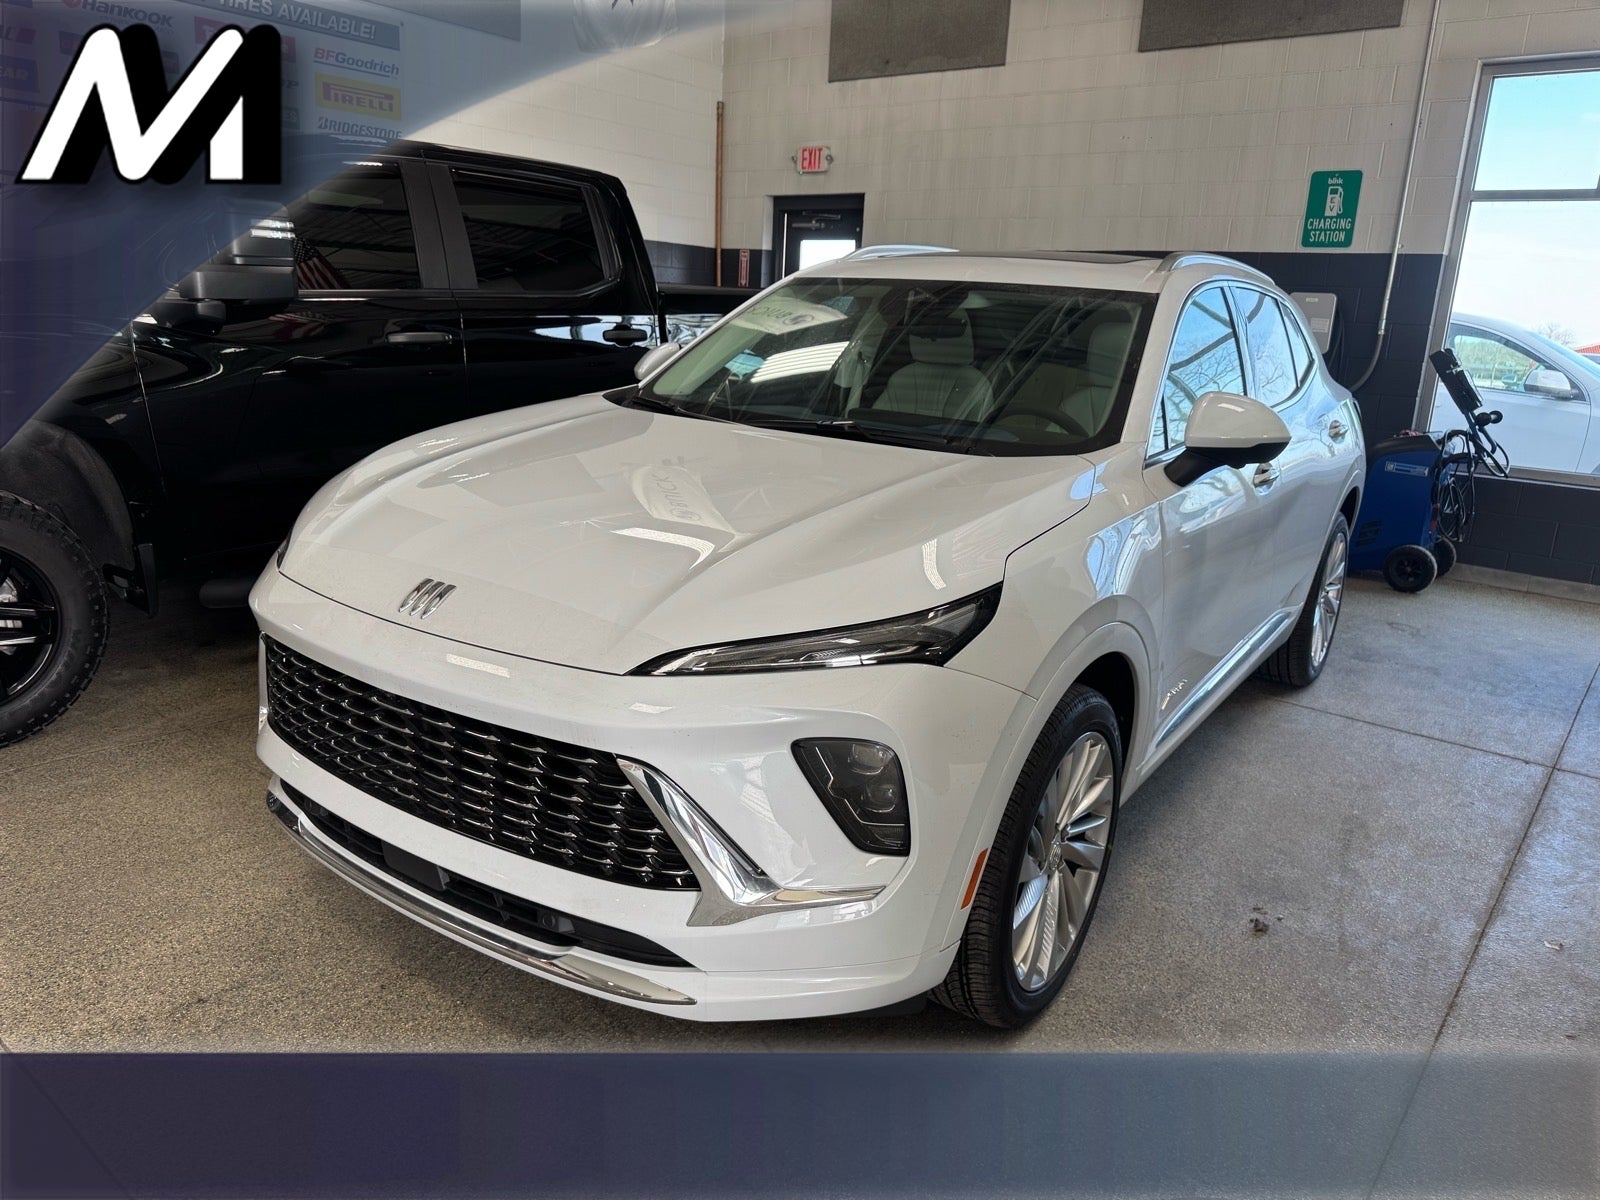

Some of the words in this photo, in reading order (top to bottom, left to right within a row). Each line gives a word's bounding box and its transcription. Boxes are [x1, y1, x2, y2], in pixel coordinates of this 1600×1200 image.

[277, 3, 377, 39] AVAILABLE!
[314, 47, 400, 76] BFGoodrich
[322, 81, 394, 113] PIRELLI
[801, 147, 823, 171] EXIT
[1307, 218, 1352, 230] CHARGING
[1309, 230, 1346, 243] STATION
